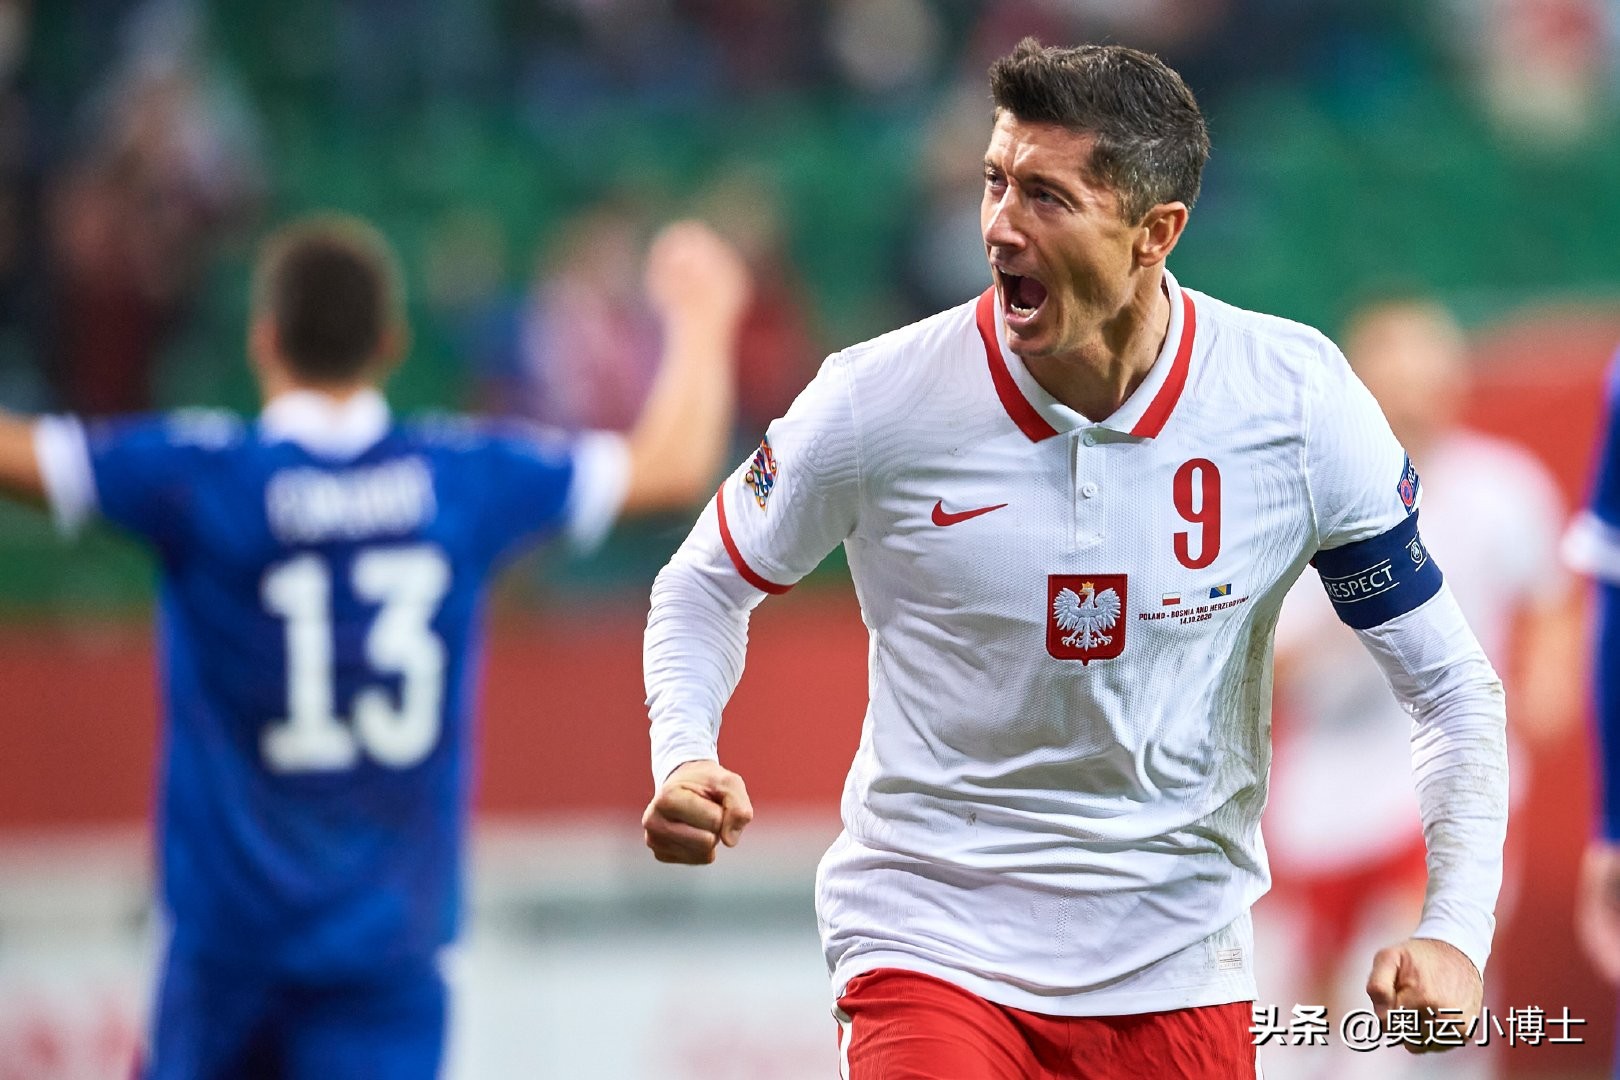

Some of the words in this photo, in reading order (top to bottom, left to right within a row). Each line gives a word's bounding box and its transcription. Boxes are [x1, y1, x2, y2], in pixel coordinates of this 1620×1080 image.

[1173, 458, 1221, 569] 9
[1325, 564, 1393, 598] RESPECT
[1139, 611, 1166, 620] POLAND
[1171, 607, 1195, 618] BOSNIA
[1196, 605, 1209, 614] AND
[1180, 613, 1212, 625] 14.10.2020
[262, 551, 450, 771] 13
